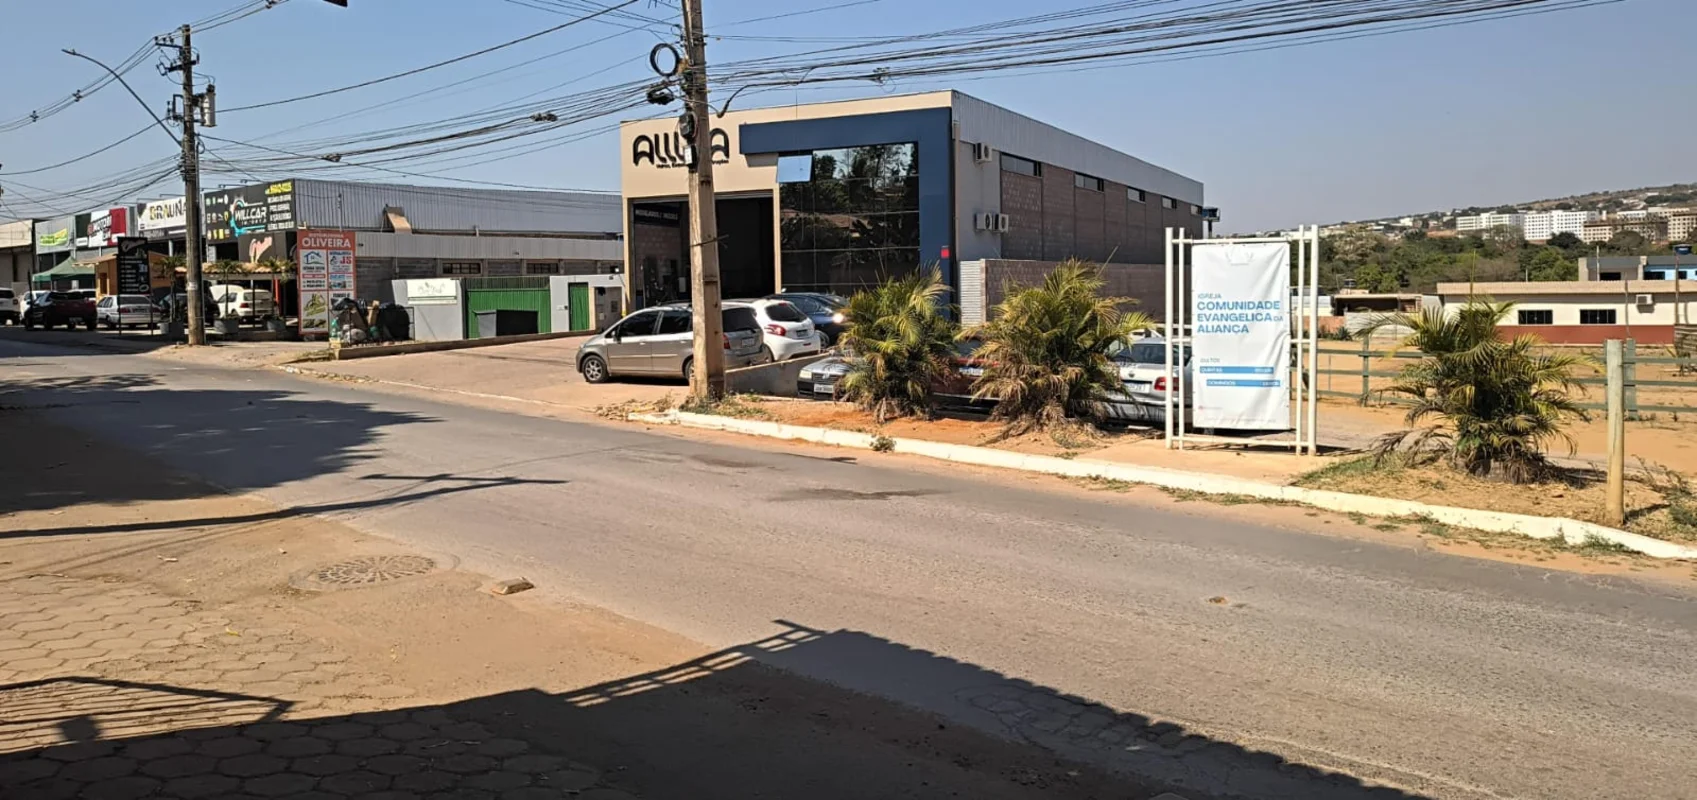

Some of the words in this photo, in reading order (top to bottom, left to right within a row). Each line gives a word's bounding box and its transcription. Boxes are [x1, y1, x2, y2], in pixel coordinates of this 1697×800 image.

[235, 206, 267, 221] WILLCAR
[302, 236, 352, 248] OLIVEIRA
[1197, 300, 1280, 310] COMUNIDADE
[1197, 312, 1272, 322] EVANGELICA
[1197, 324, 1249, 335] ALIANÇA
